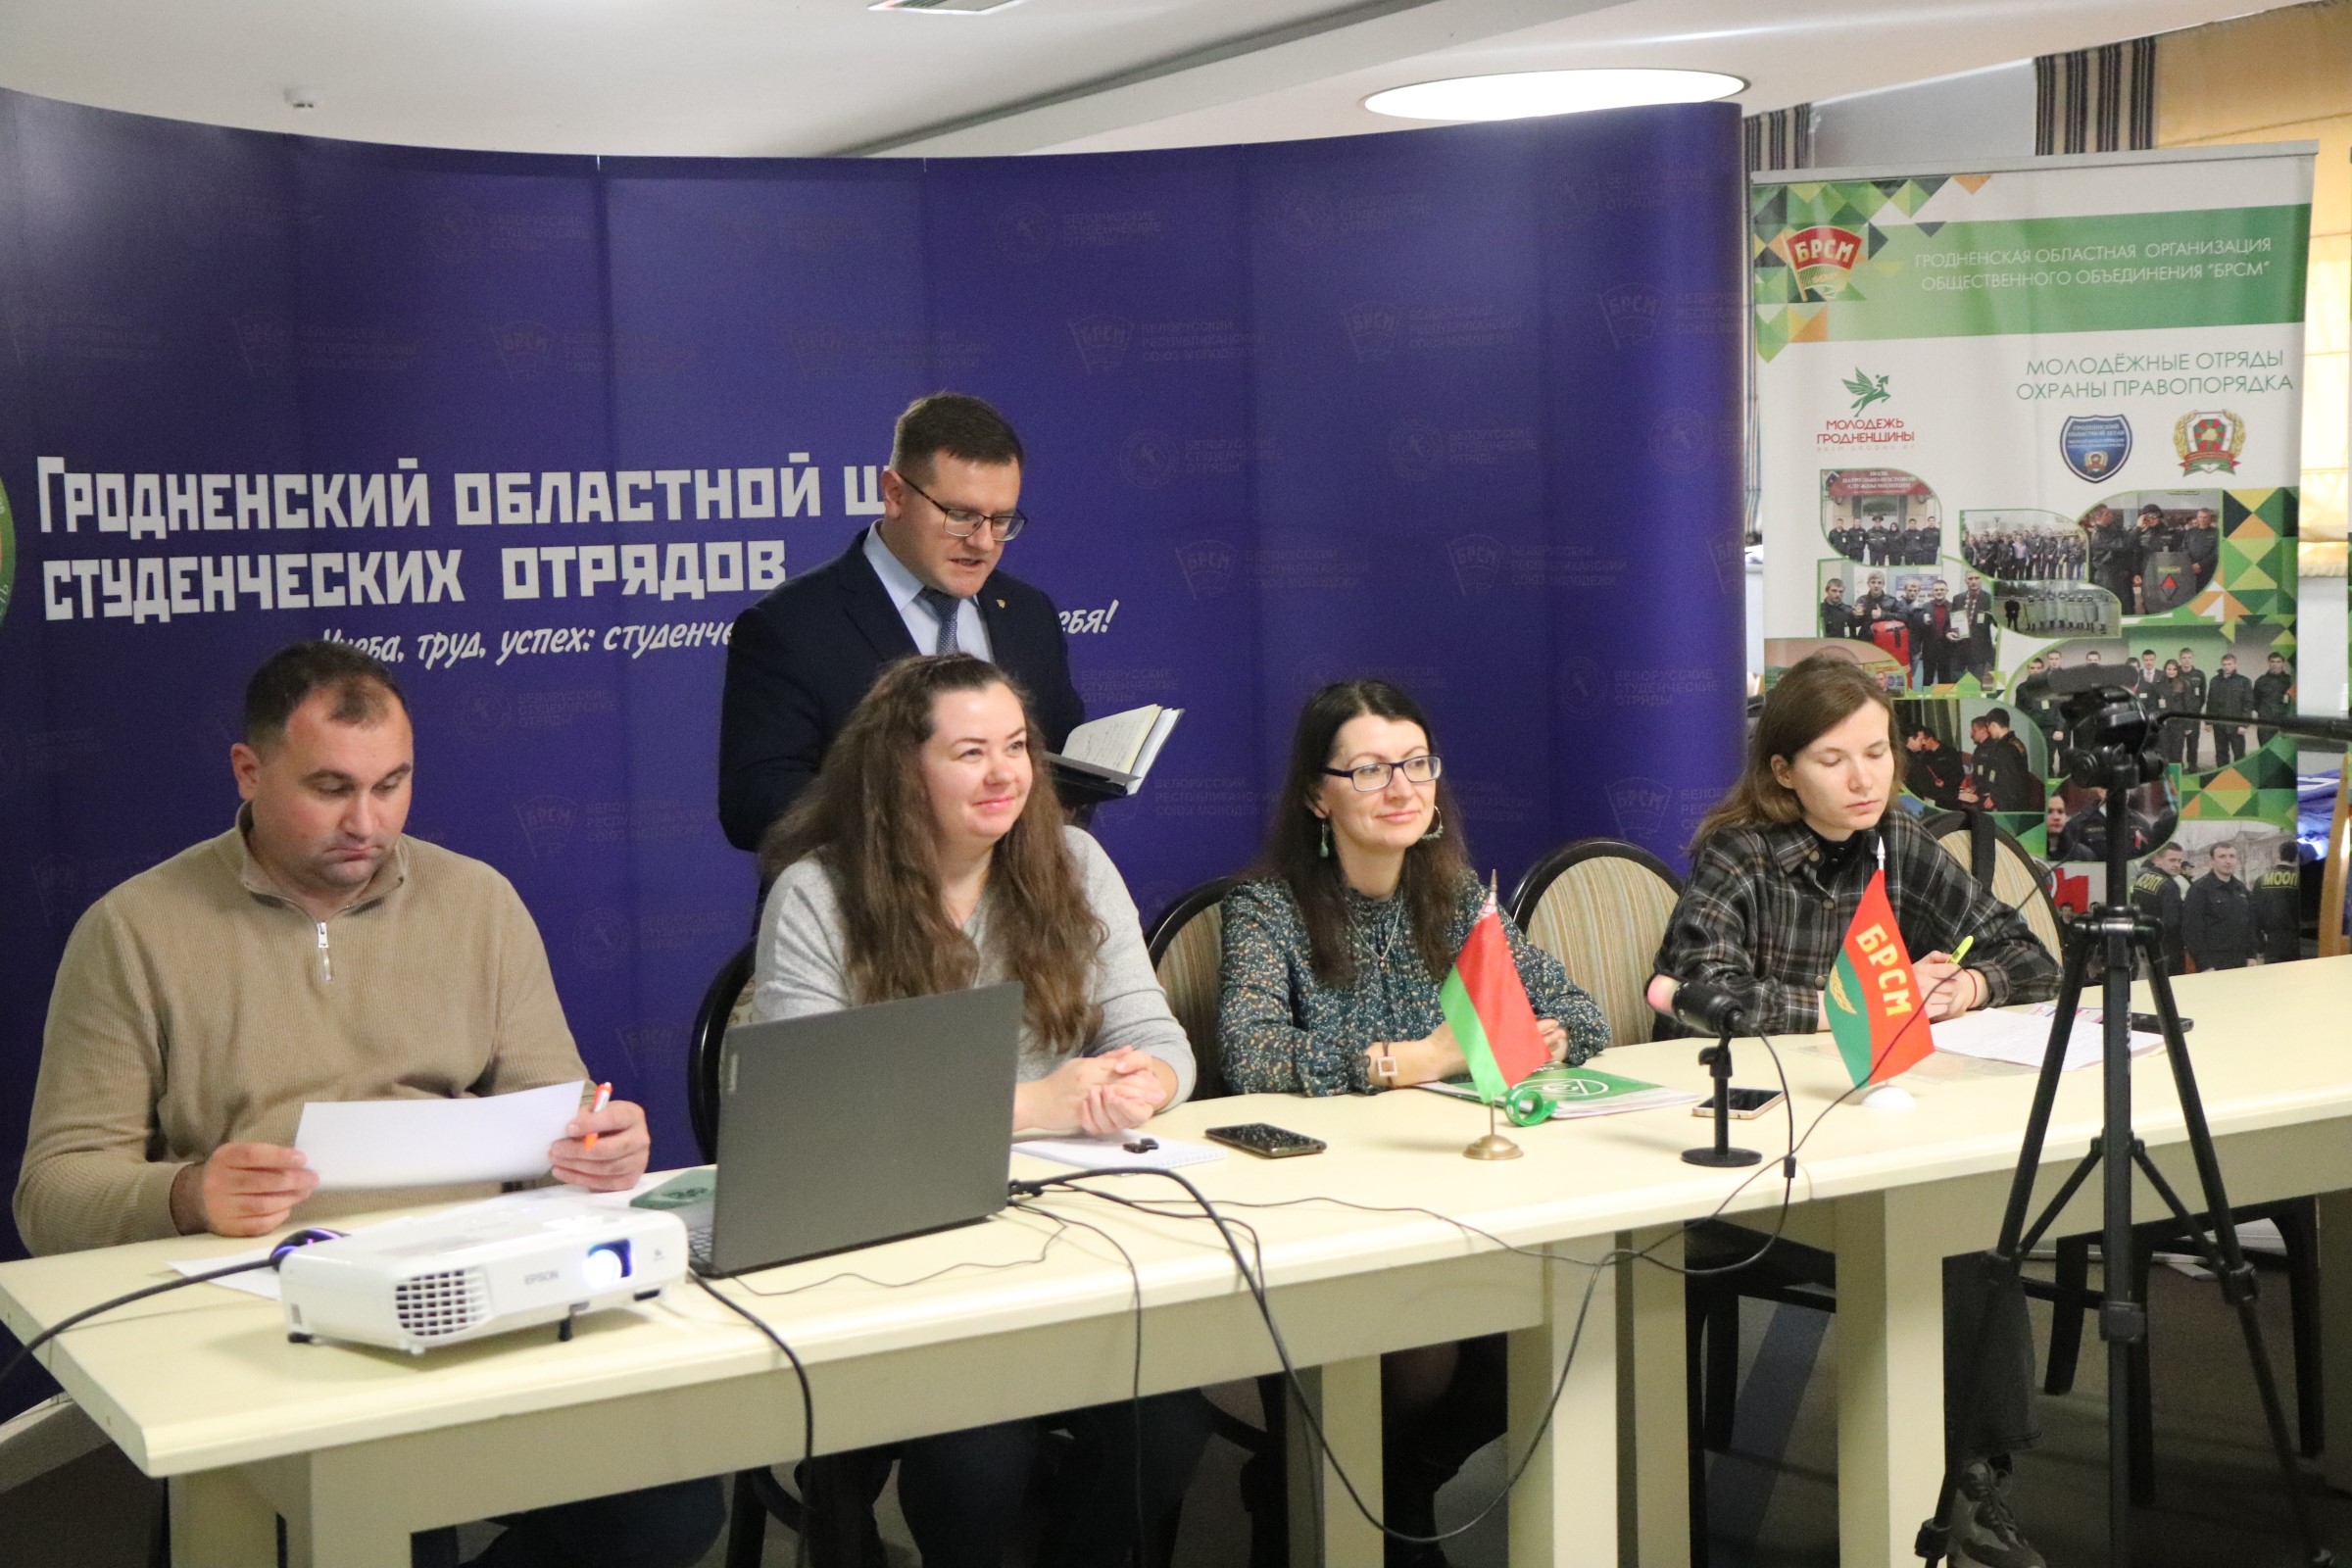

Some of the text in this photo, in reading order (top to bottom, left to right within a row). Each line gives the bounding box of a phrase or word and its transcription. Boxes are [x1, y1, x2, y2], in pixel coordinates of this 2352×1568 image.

[1794, 239, 1855, 264] БРСМ
[1914, 237, 2272, 269] ГРОДНЕНСКАЯ ОБЛАСТНАЯ ОРГАНИЗАЦИЯ
[1921, 270, 2072, 291] ОБЩЕСТВЕННОГО
[2076, 264, 2203, 285] ОБЪЕДИНЕНИЯ
[2026, 350, 2283, 376] МОЛОДЁЖНЫЕ ОТРЯДЫ
[2016, 374, 2294, 400] ОХРАНЫ ПРАВОПОРЯДКА
[1826, 417, 1904, 430] МОЛОДЕЖЬ
[454, 452, 821, 526] ОБЛАСТНОЙ
[43, 549, 466, 624] СТУДЕНЧЕСКИХ
[502, 540, 786, 601] ОТРЯДОВ
[416, 630, 487, 670] труд,
[496, 626, 595, 666] успех:
[1855, 922, 1913, 1016] БРСМ
[524, 1270, 560, 1286] EPSON
